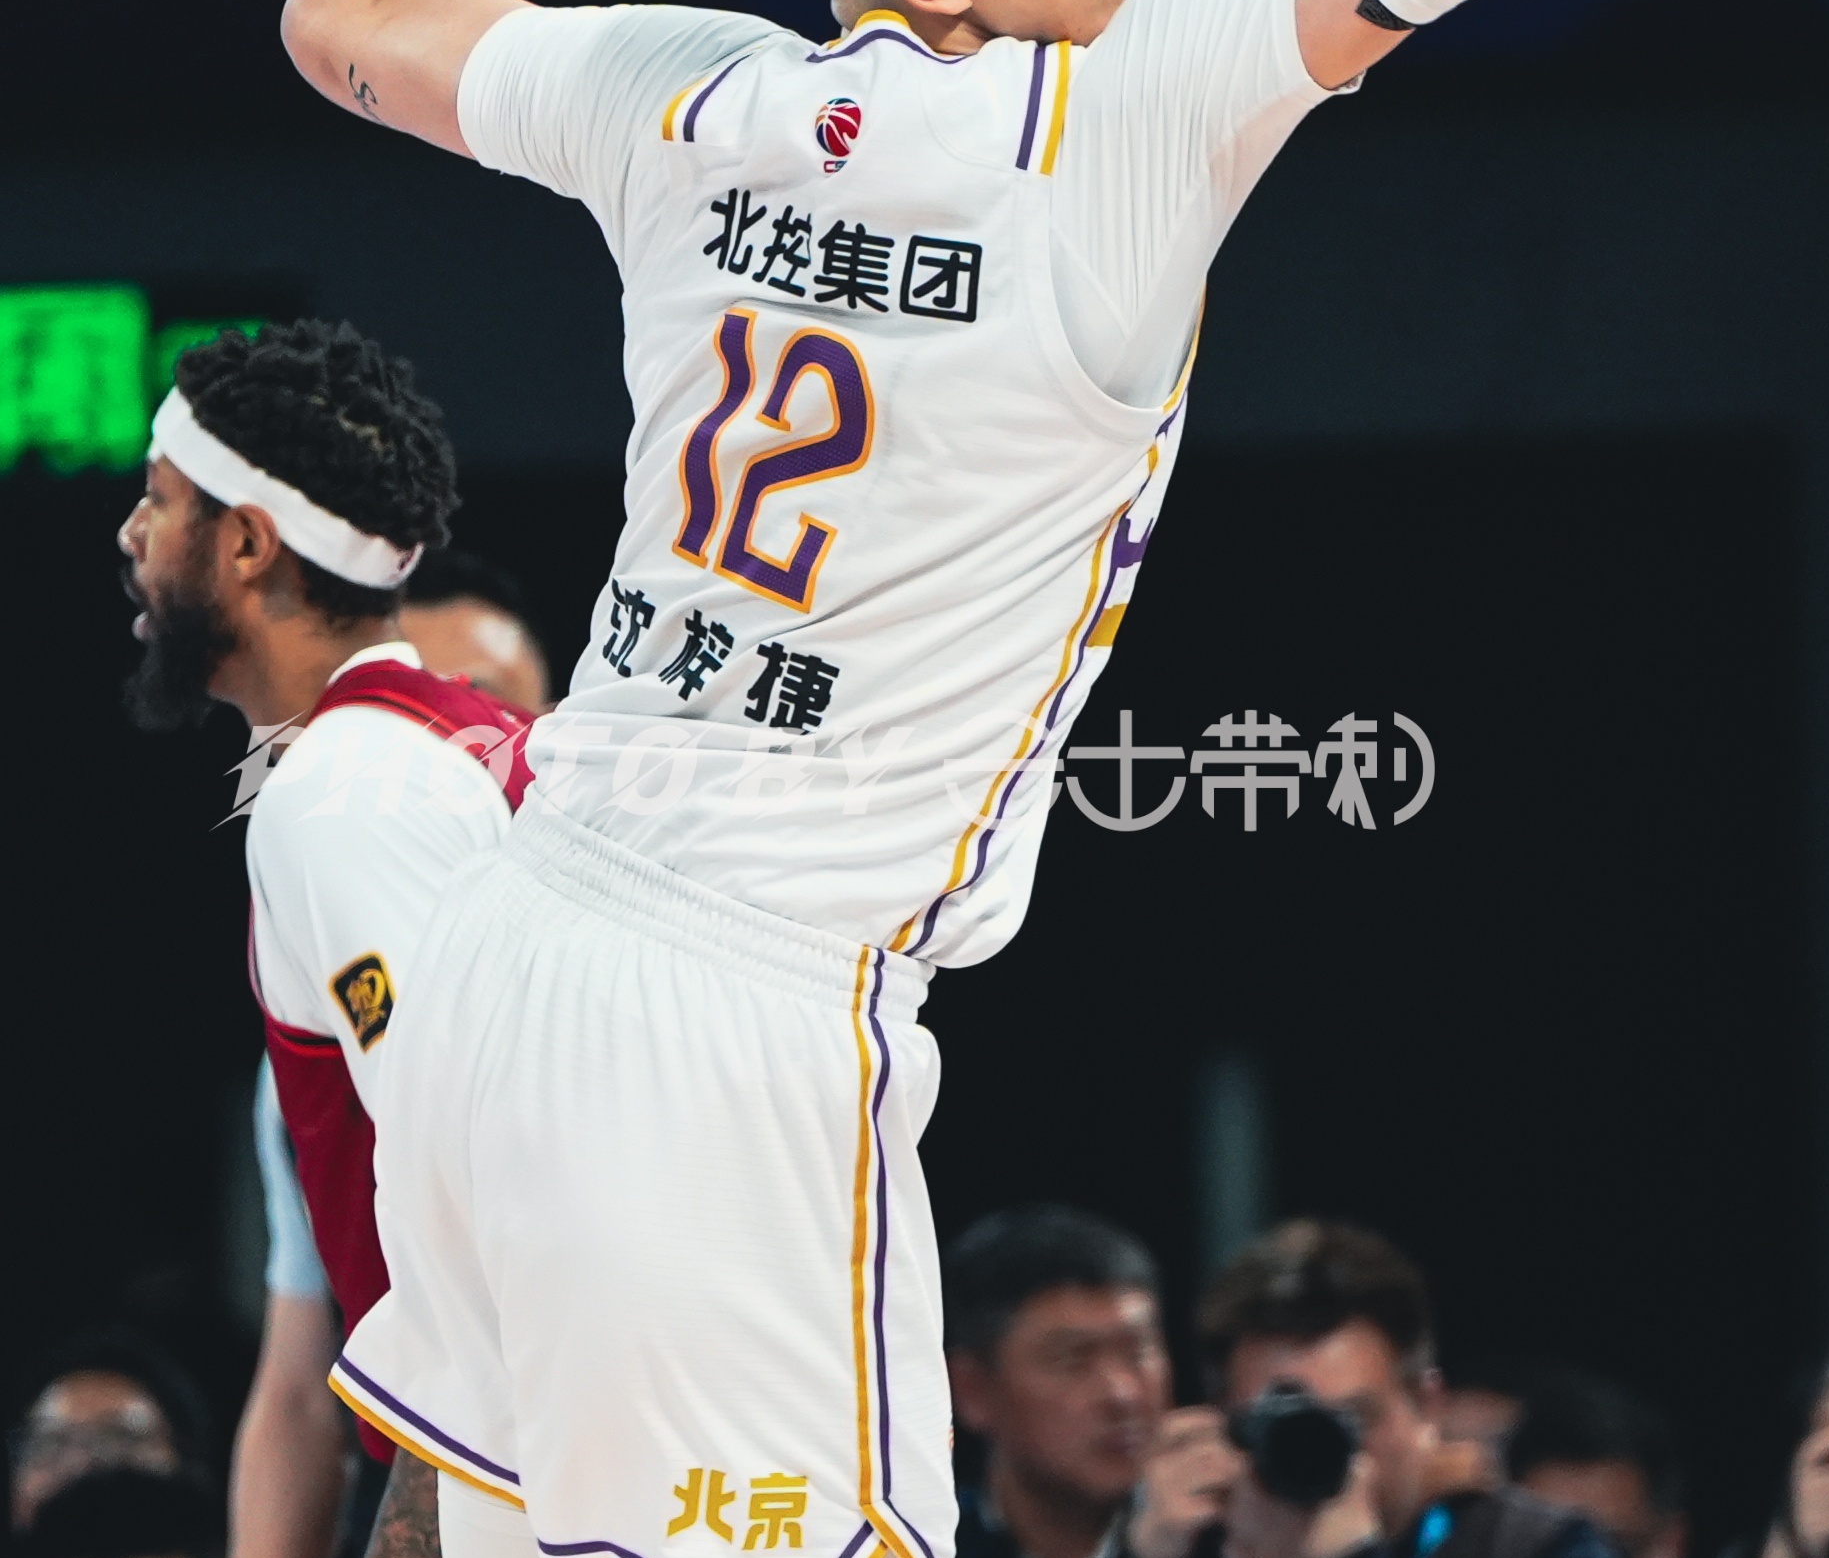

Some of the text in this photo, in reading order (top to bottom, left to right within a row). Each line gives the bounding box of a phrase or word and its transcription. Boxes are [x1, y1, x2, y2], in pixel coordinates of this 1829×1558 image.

[703, 188, 983, 323] 北控集团
[672, 306, 876, 615] 12
[666, 1467, 808, 1551] 北京
